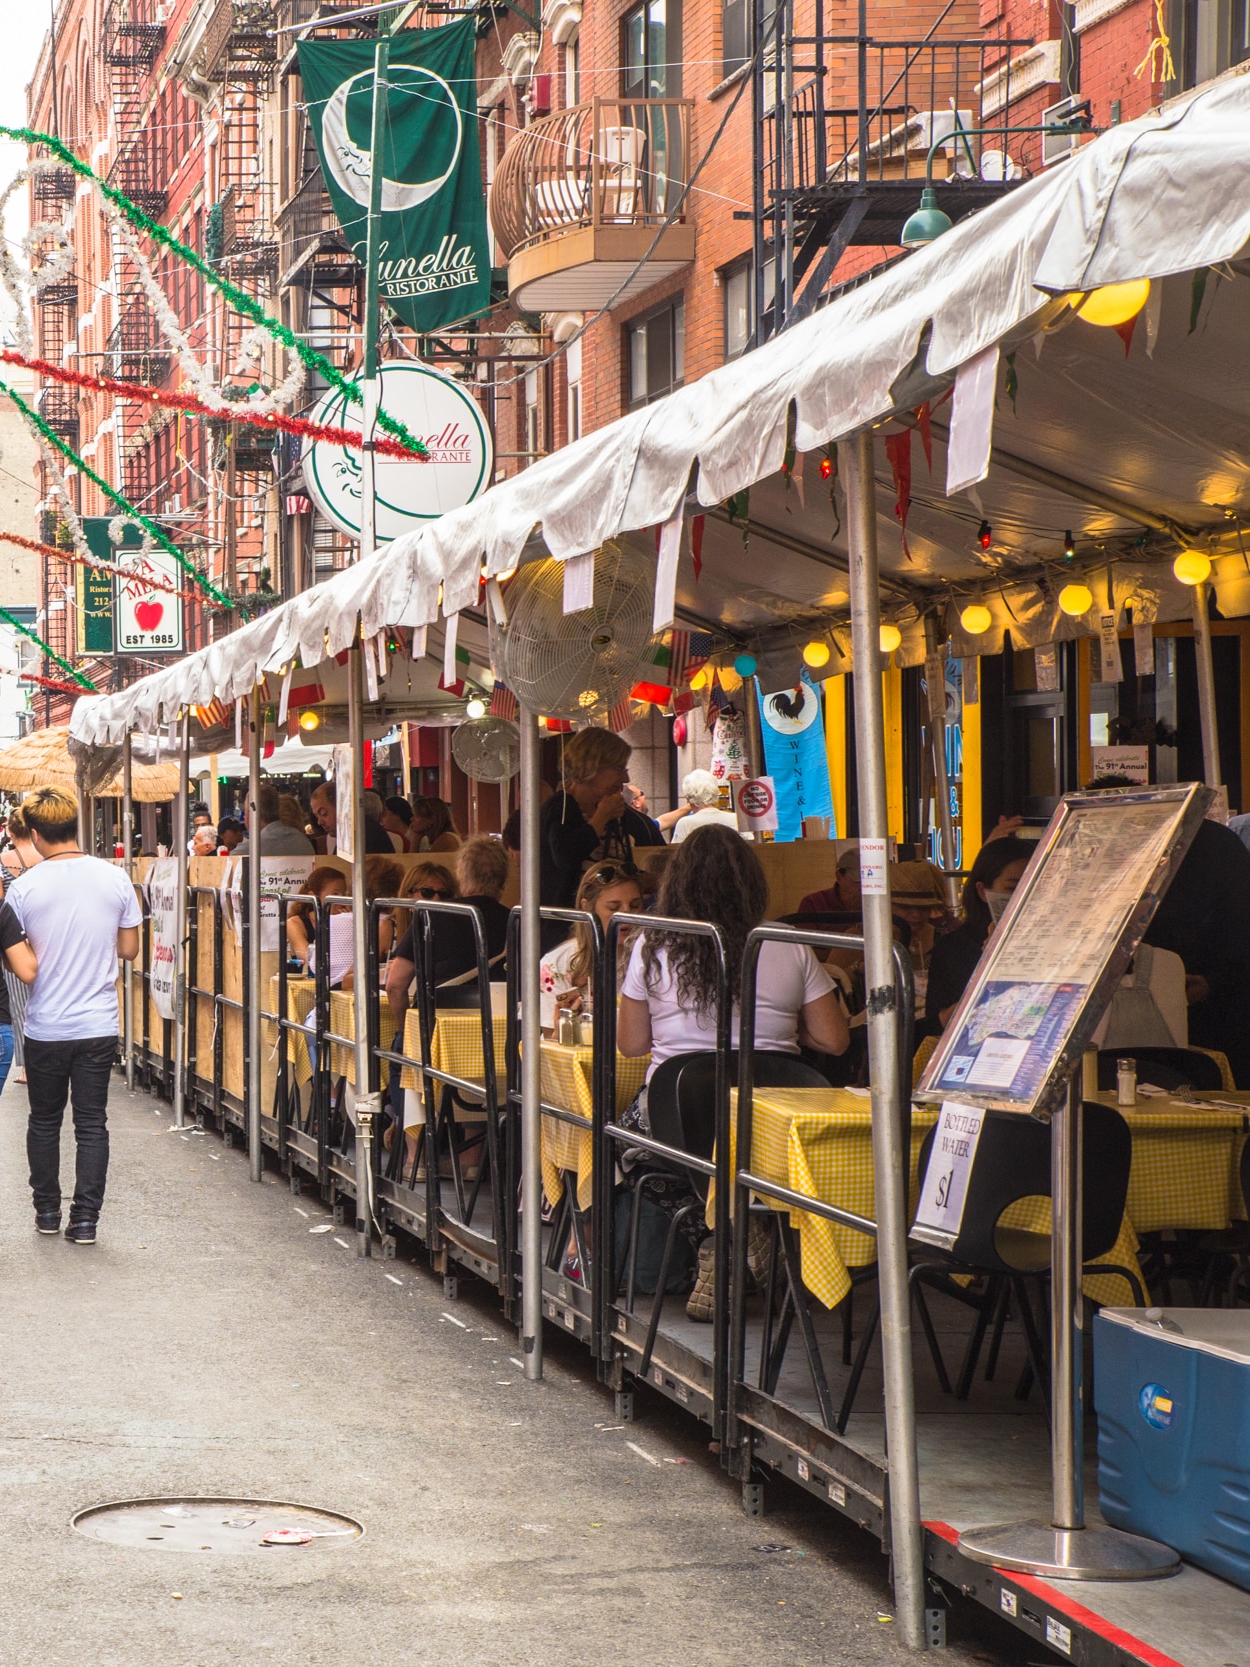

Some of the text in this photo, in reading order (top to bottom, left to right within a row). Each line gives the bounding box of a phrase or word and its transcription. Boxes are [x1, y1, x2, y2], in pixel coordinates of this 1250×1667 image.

[387, 268, 478, 296] RISTORANTE
[125, 573, 174, 600] MEA
[126, 634, 174, 645] EST 1985
[1106, 762, 1119, 770] 91st
[1120, 762, 1147, 770] Annual
[268, 876, 283, 886] 91st
[284, 876, 307, 885] Annu
[943, 1112, 981, 1136] BOTTLED
[942, 1136, 970, 1158] WATER
[935, 1168, 955, 1210] $1
